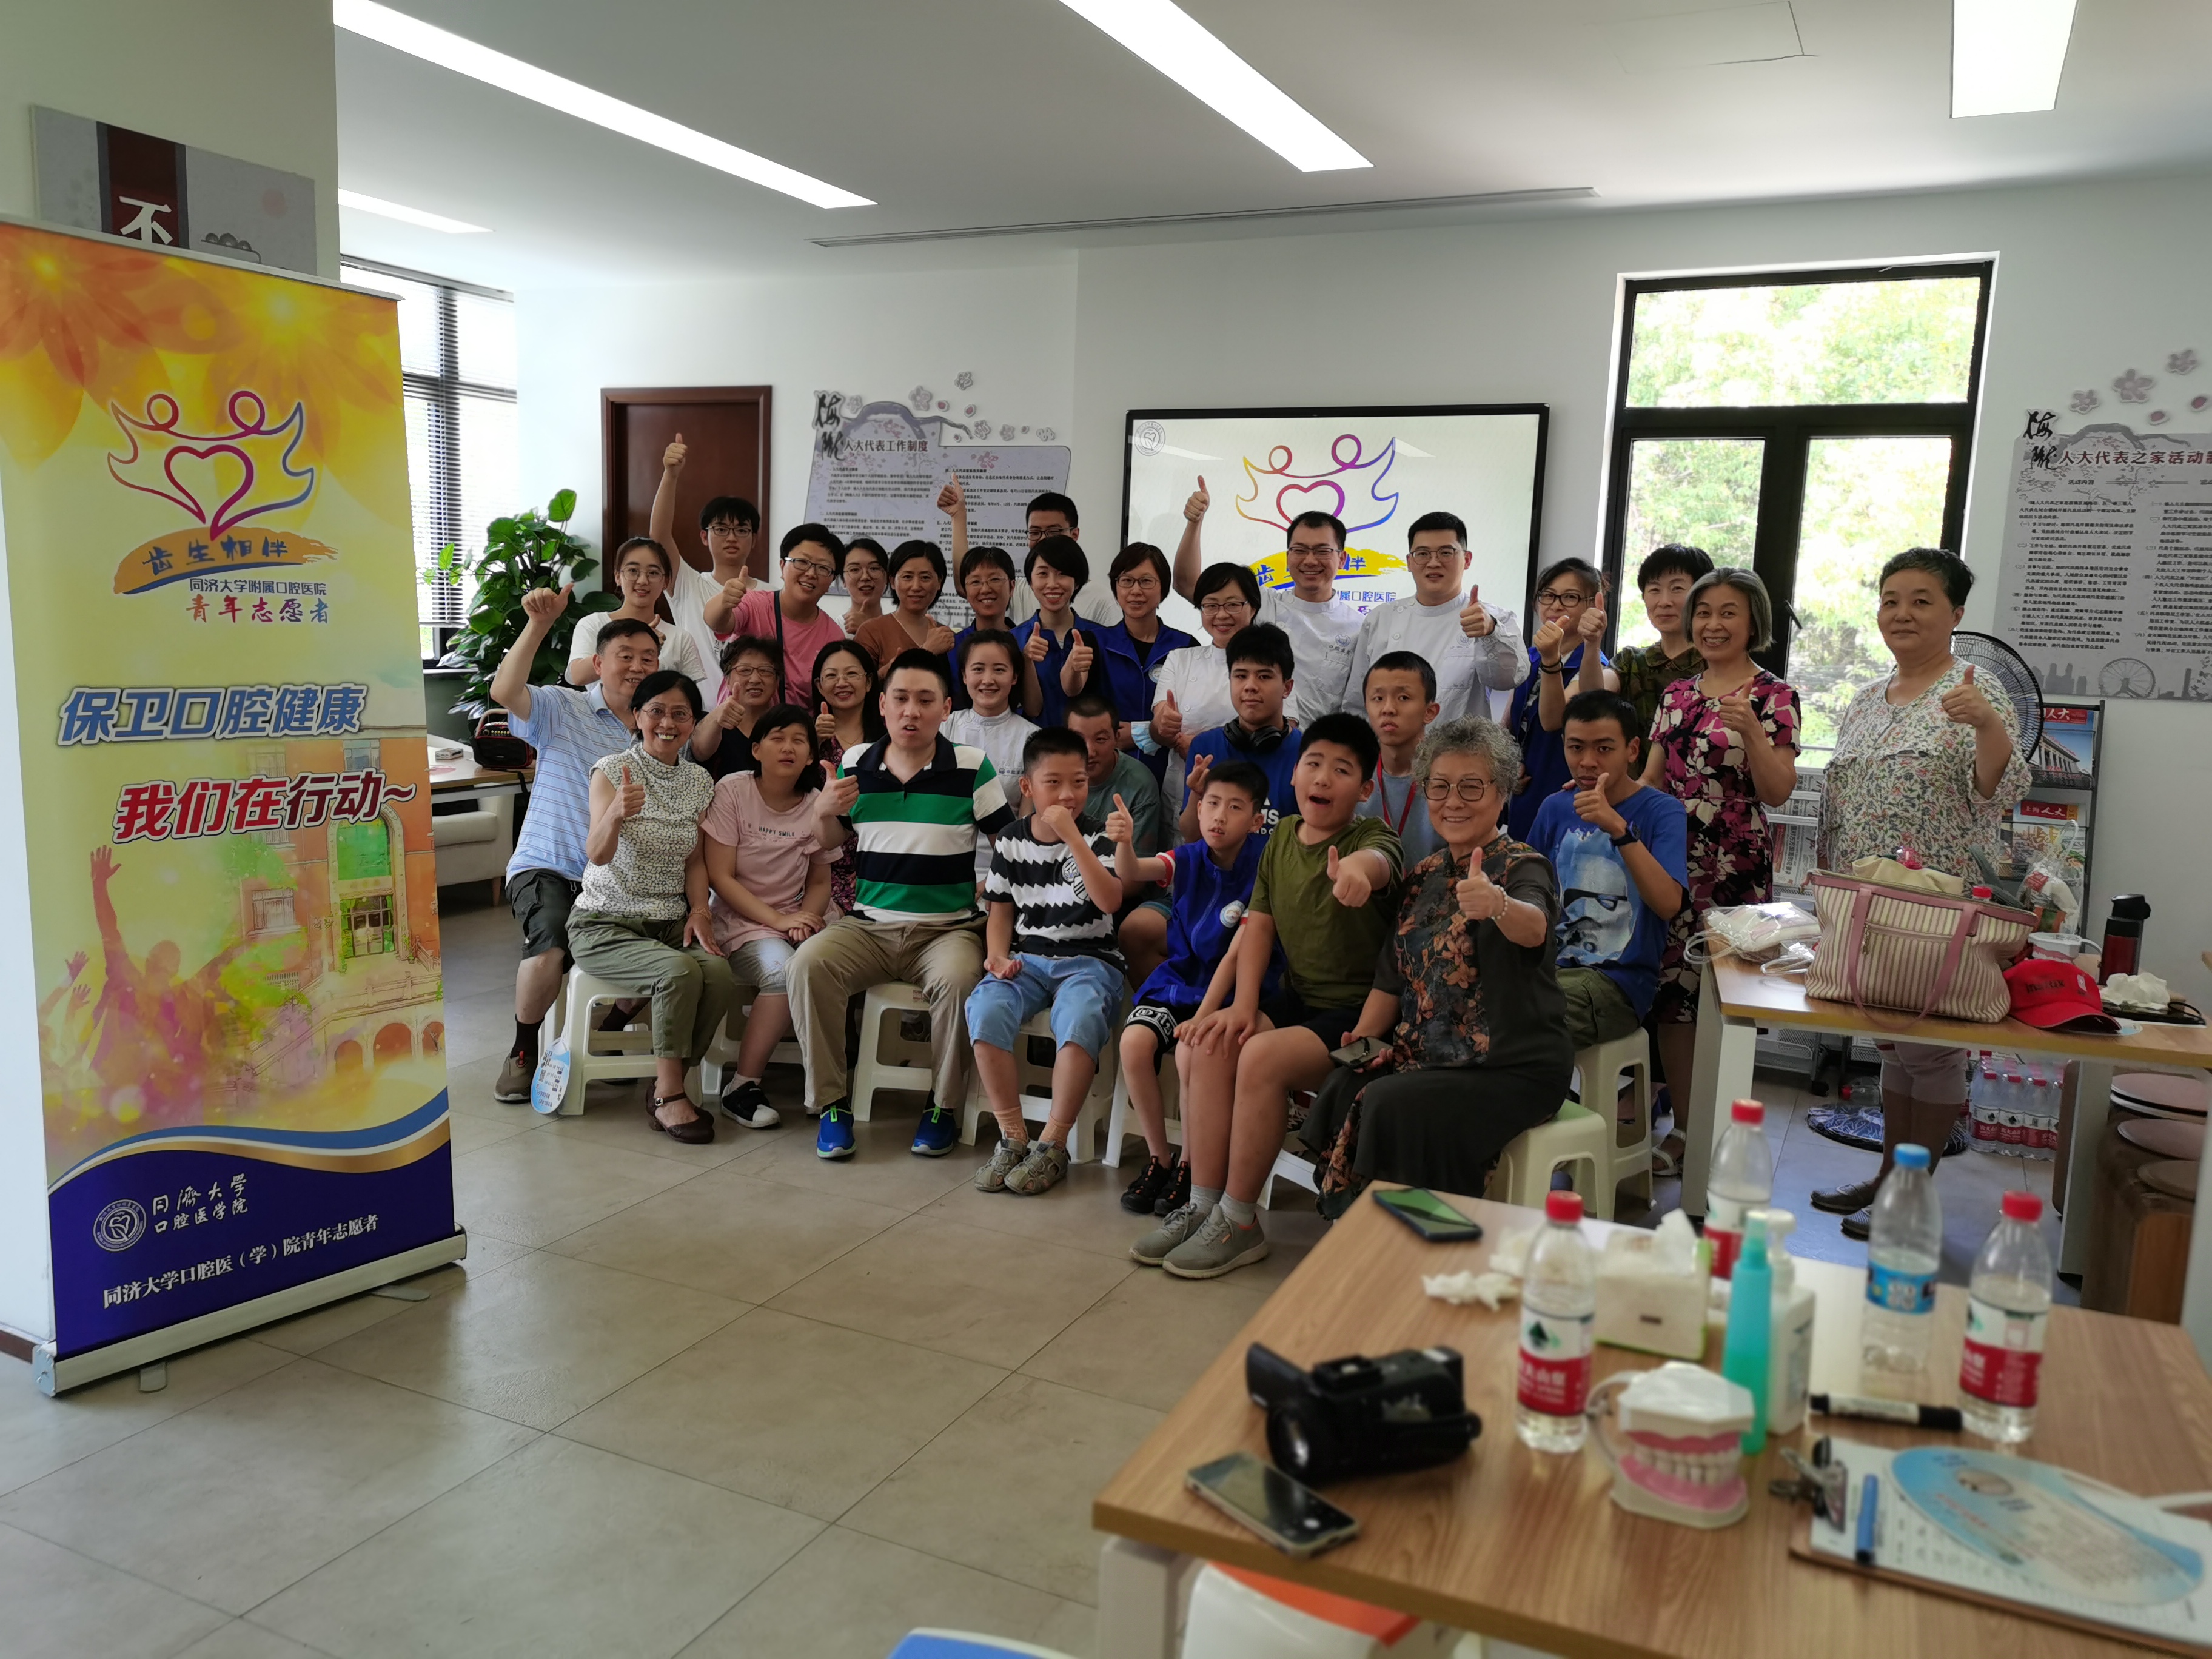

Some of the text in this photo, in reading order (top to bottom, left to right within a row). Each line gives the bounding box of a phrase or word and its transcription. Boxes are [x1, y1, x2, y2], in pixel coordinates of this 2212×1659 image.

[119, 196, 174, 244] 不
[843, 440, 928, 452] 人大代表工作制度
[142, 534, 289, 576] 齿生相伴
[189, 578, 327, 595] 同济大学附属口腔医院
[1337, 590, 1397, 603] 属口腔医院
[186, 594, 329, 624] 青年志愿者
[59, 685, 367, 745] 保卫口腔健康
[759, 826, 776, 835] HAPPY
[154, 1197, 248, 1233] 口腔医学院
